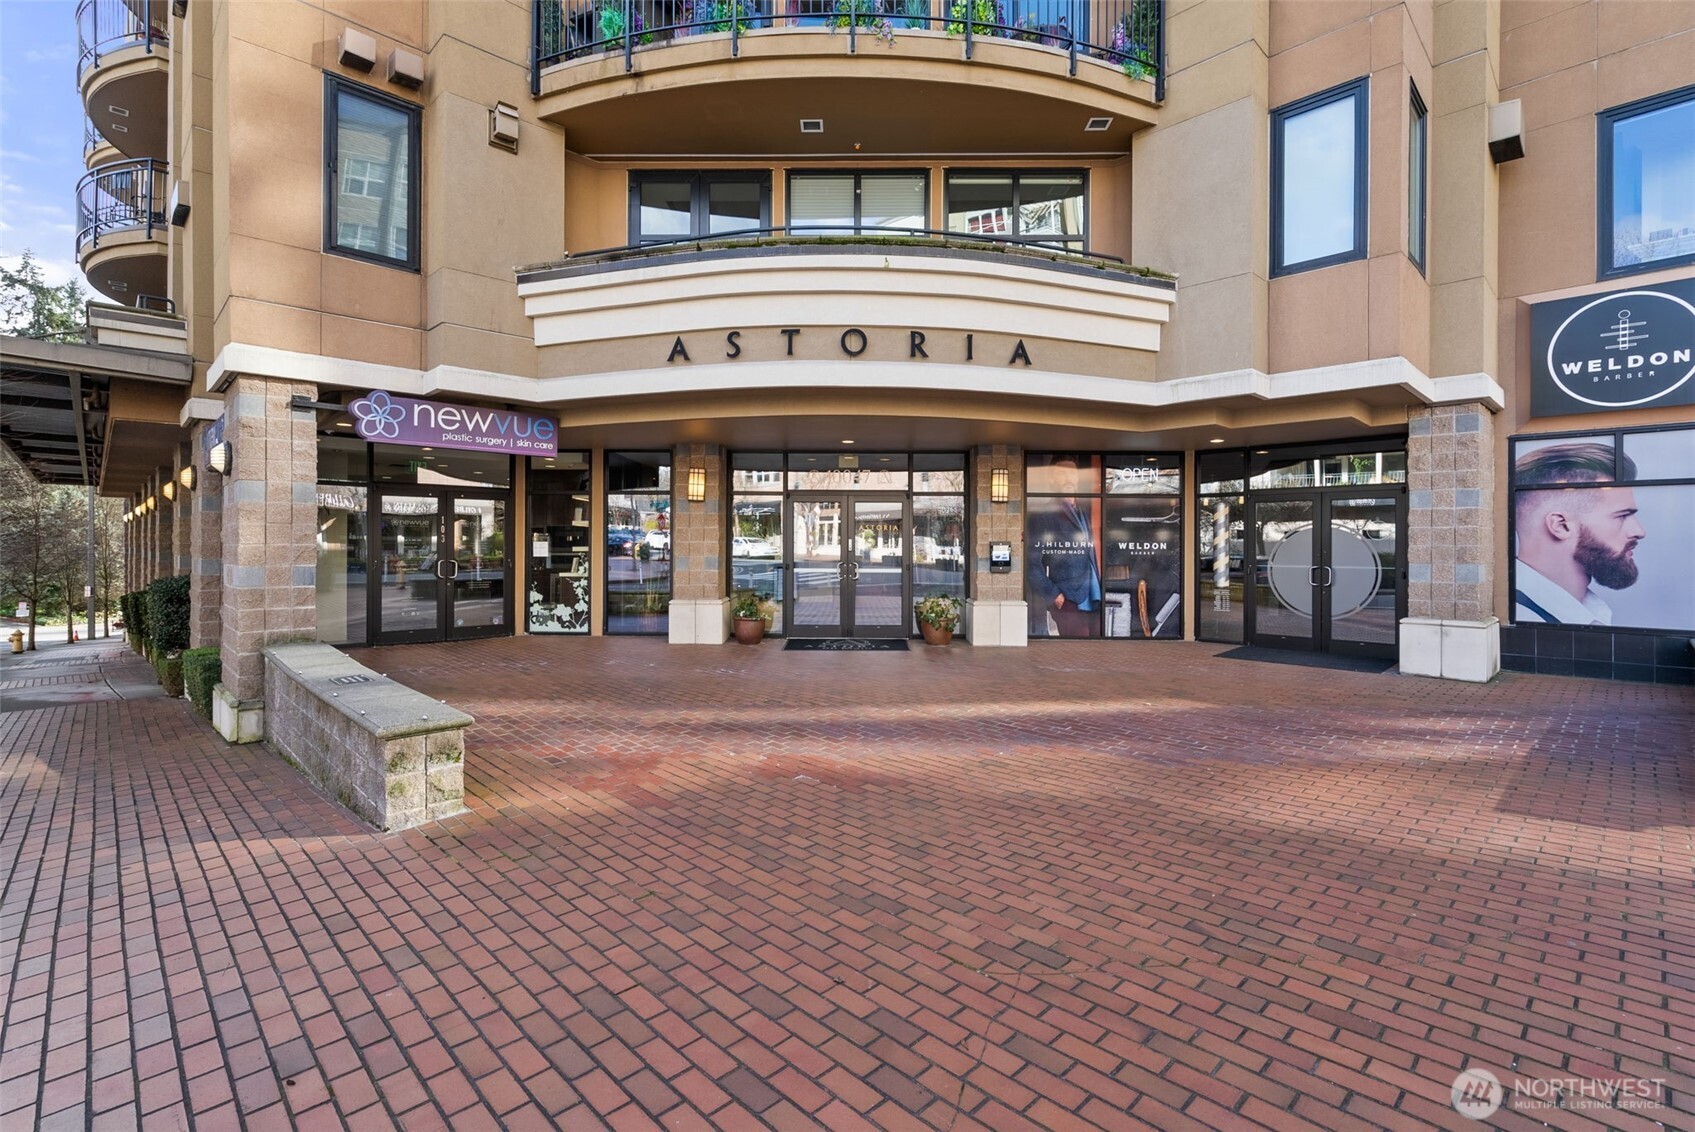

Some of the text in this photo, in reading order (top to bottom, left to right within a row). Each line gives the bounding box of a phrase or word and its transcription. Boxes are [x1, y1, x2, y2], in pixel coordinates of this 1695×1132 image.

[666, 327, 1032, 365] ASTORIA
[1562, 349, 1691, 376] WELDON
[1593, 371, 1655, 382] BARBER
[413, 403, 554, 440] newvue
[442, 432, 473, 443] plastic
[475, 436, 507, 447] surgery
[516, 439, 532, 448] skin
[534, 442, 554, 450] care
[1121, 467, 1159, 482] OPEN
[858, 524, 899, 532] ASTORIA
[1118, 542, 1168, 550] WELDON
